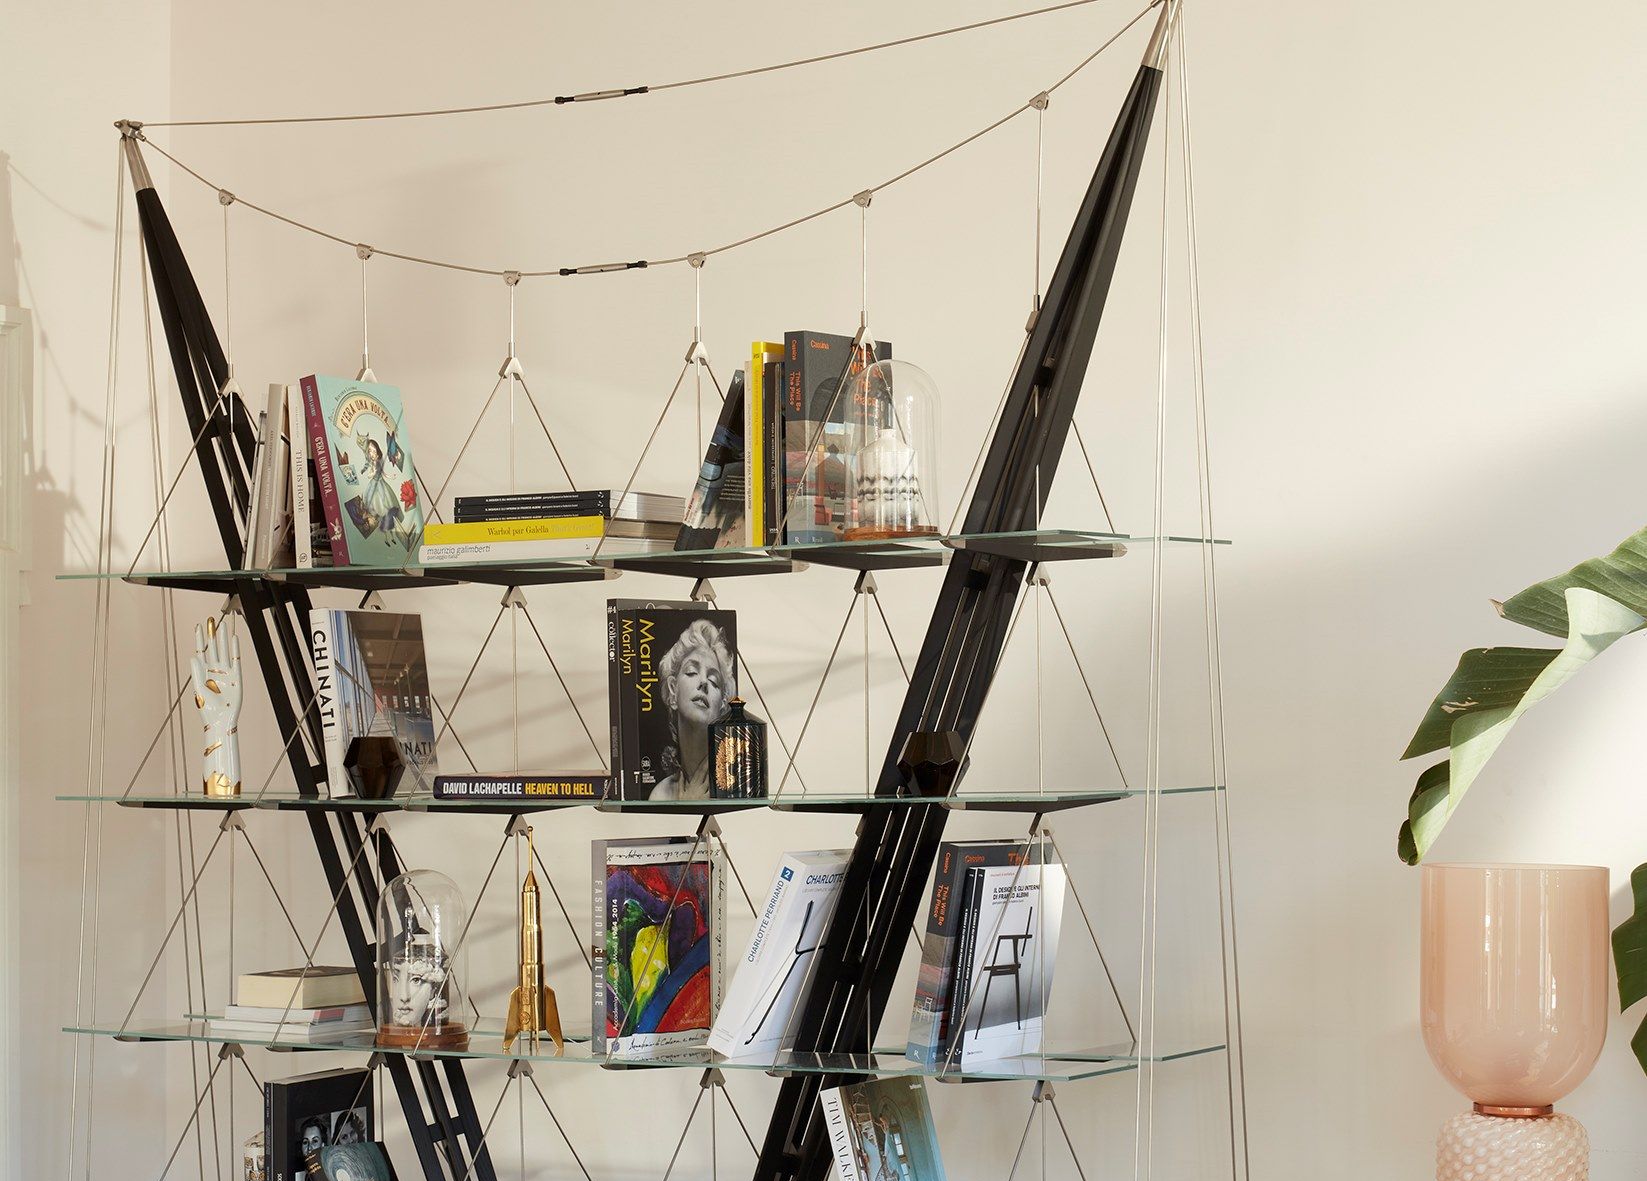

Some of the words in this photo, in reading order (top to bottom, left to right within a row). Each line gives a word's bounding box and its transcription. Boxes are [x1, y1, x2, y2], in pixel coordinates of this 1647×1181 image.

[354, 399, 369, 411] UNA
[295, 449, 303, 471] THIS
[319, 457, 328, 474] UNA
[296, 473, 304, 484] IS
[297, 485, 305, 513] HOME
[487, 527, 511, 537] Warhol
[512, 528, 524, 537] par
[525, 525, 549, 535] Galella
[426, 545, 456, 556] maurizio
[456, 544, 491, 555] galimberti
[620, 618, 636, 675] Marilyn
[312, 630, 336, 728] CHINATI
[635, 618, 659, 712] Marilyn
[443, 782, 467, 795] DAVID
[469, 782, 523, 795] LACHAPELLE
[524, 782, 559, 795] HEAVEN
[560, 783, 571, 795] TO
[573, 783, 594, 795] HELL
[595, 880, 603, 937] FASHION
[747, 919, 770, 963] CHARLOTTE
[766, 880, 784, 921] PERRIAND
[595, 947, 603, 1006] CULTURE
[828, 1097, 842, 1126] TIM
